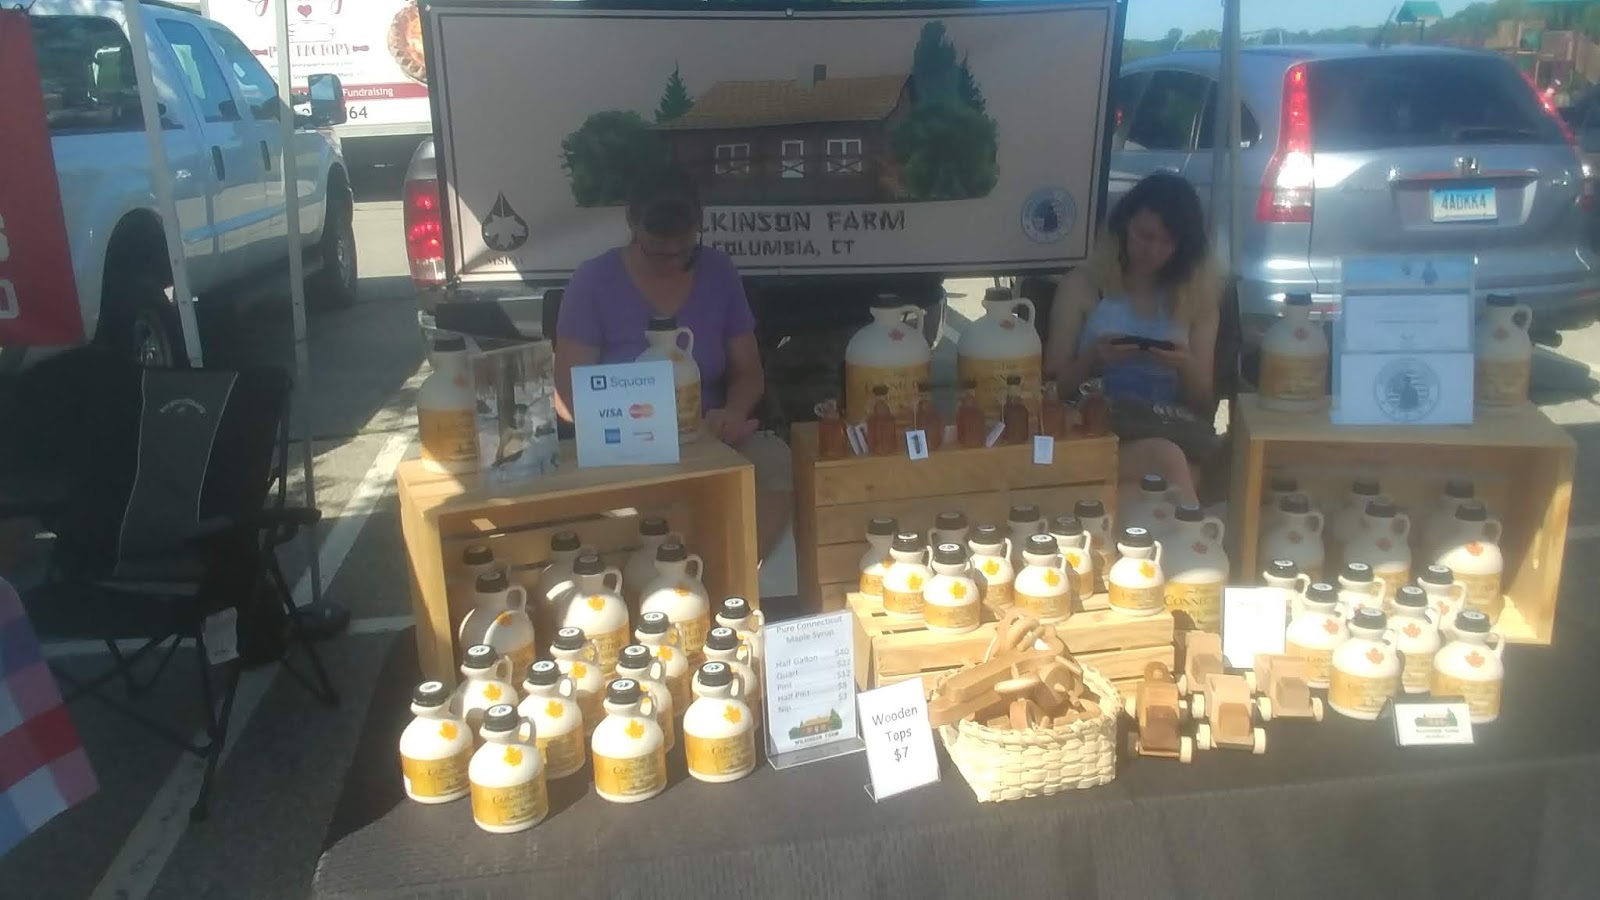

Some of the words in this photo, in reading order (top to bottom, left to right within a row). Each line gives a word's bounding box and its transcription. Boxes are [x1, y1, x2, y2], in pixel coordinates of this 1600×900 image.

[296, 43, 350, 57] FACTORY
[343, 87, 394, 98] Fundraising
[703, 210, 811, 232] KINSON
[827, 209, 905, 231] FARM
[832, 240, 855, 255] CT
[610, 376, 656, 389] Square
[599, 408, 623, 418] VISA
[776, 624, 795, 634] Pure
[797, 615, 843, 630] Connecticut
[786, 632, 811, 644] Maple
[813, 629, 835, 639] Syrup
[776, 657, 792, 669] Half
[793, 654, 819, 666] Gallon
[776, 669, 798, 681] Quart
[777, 682, 792, 691] Pint
[871, 706, 918, 726] Wooden
[885, 728, 912, 743] Tops
[894, 746, 909, 763] $7
